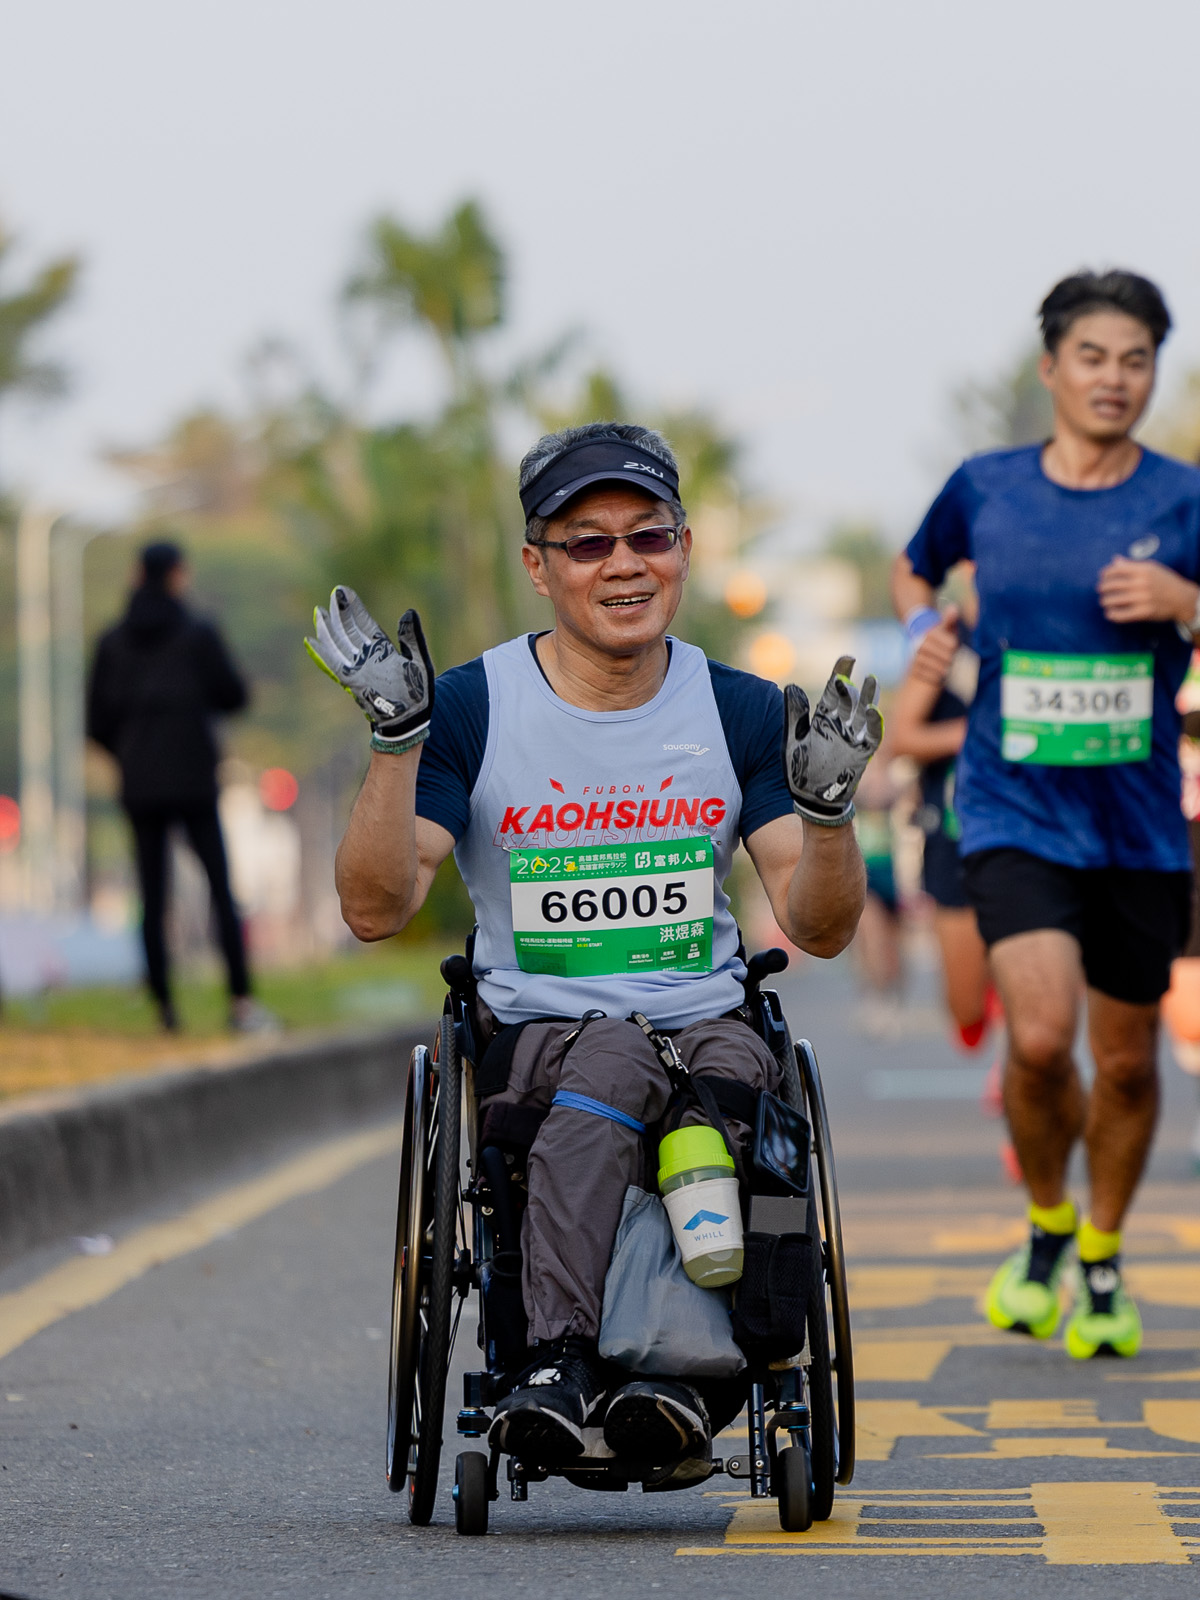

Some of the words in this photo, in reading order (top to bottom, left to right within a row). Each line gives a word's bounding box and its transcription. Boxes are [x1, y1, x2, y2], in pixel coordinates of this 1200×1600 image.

[623, 461, 664, 479] 2XU
[374, 696, 396, 718] GEL
[1024, 686, 1132, 715] 34306
[662, 743, 701, 753] saucony
[583, 784, 645, 795] FUBON
[500, 797, 727, 835] KAOHSIUNG
[516, 855, 578, 875] 2025
[654, 850, 707, 868] 富邦人壽
[541, 881, 688, 924] 66005
[659, 921, 705, 944] 洪煜森
[694, 1231, 725, 1242] WHILL
